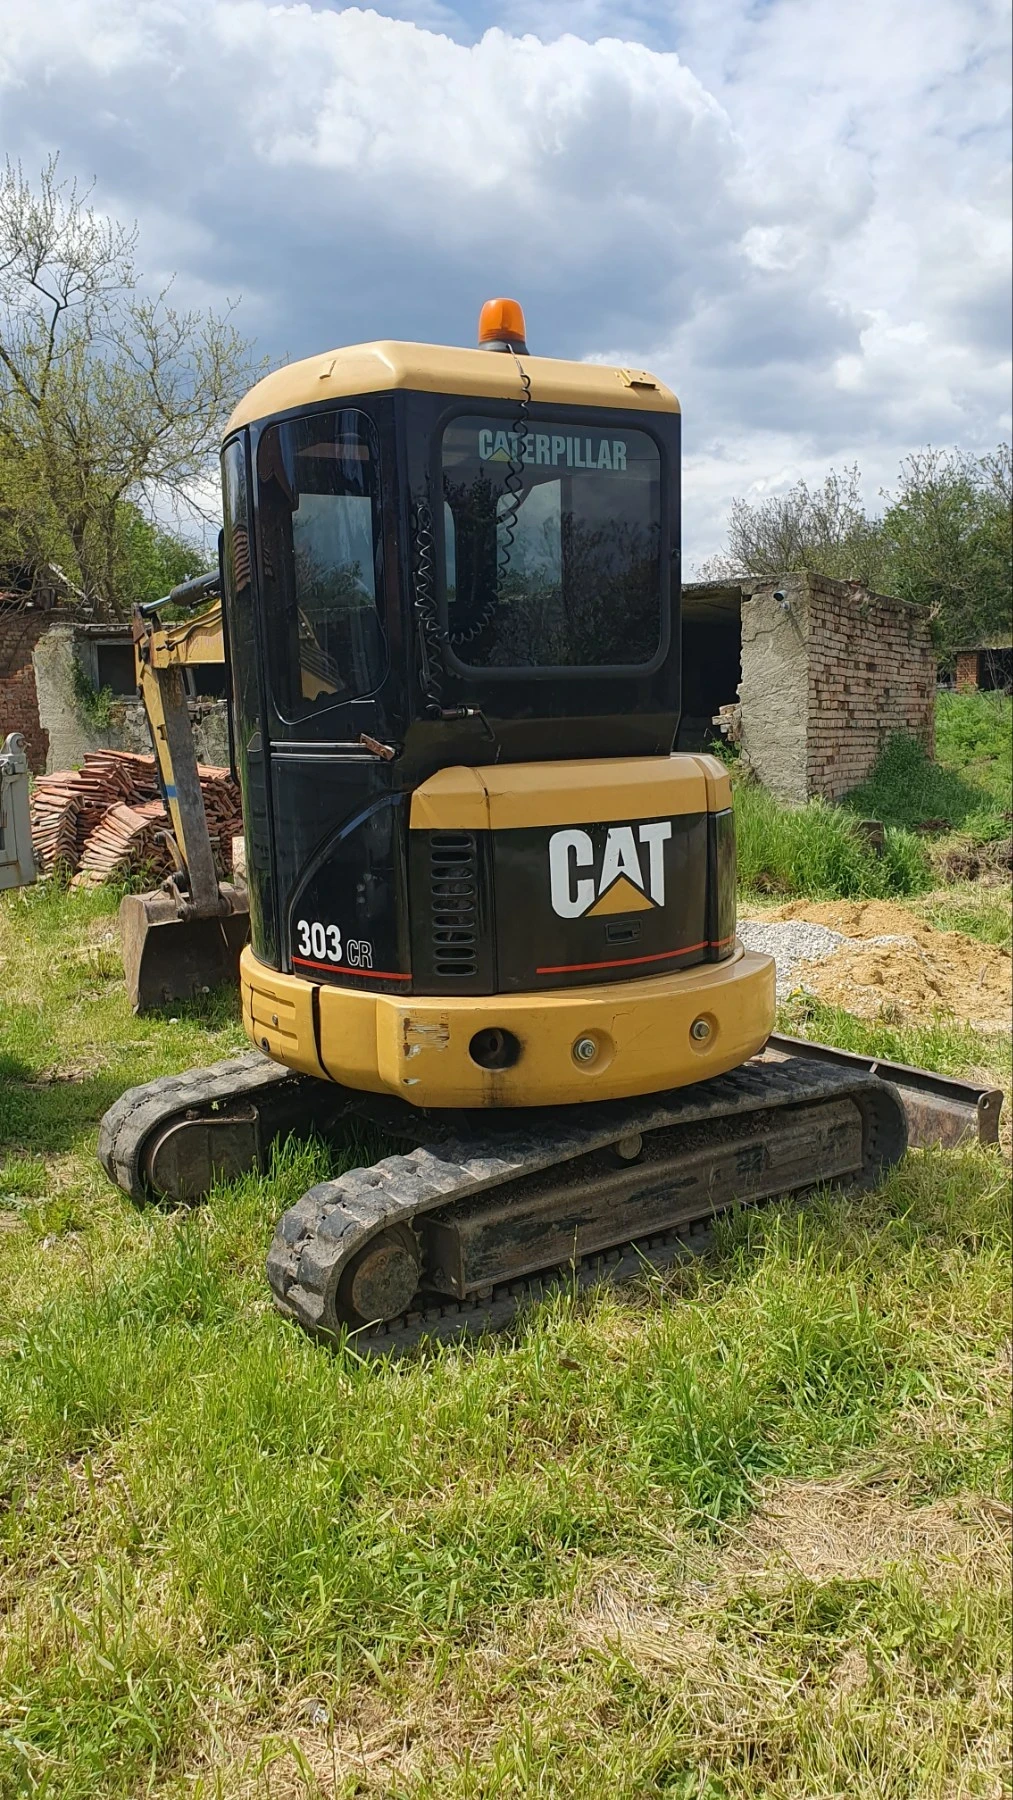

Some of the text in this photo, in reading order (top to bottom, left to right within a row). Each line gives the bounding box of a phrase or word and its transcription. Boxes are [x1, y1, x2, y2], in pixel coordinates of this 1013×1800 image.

[478, 428, 627, 471] CATERPILLAR
[549, 821, 672, 919] CAT
[297, 919, 373, 969] 303 CR
